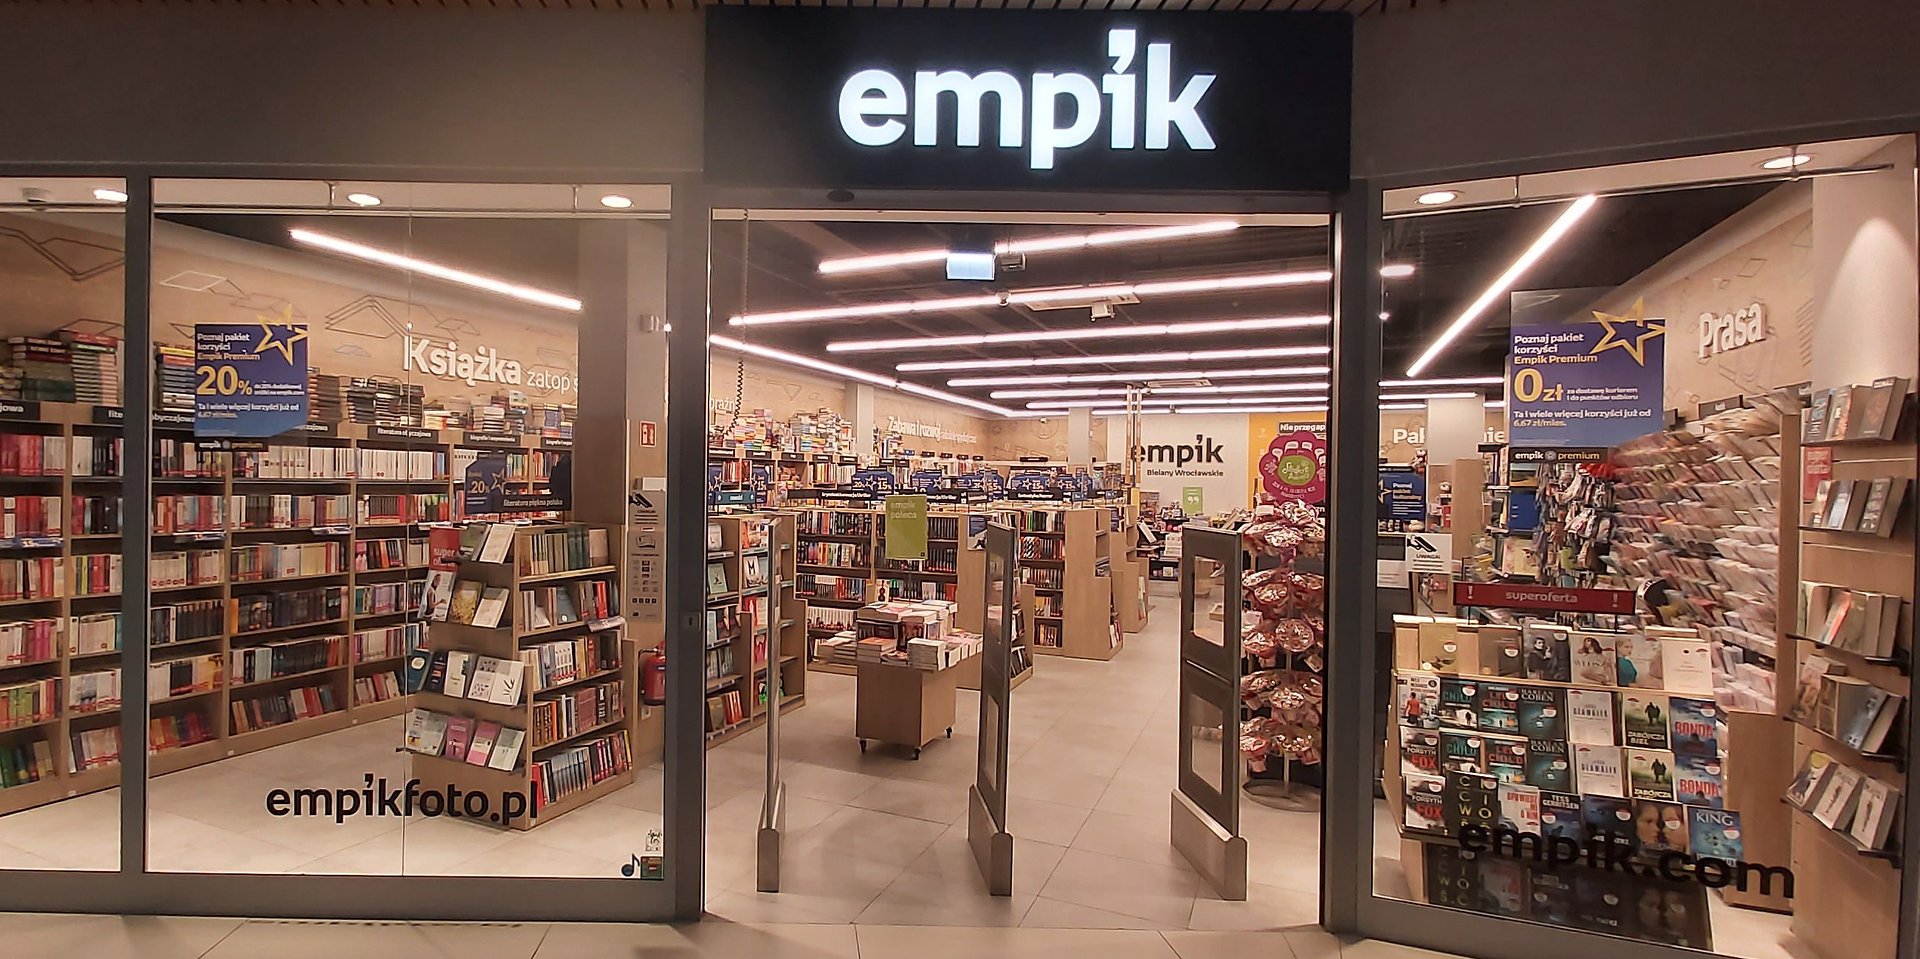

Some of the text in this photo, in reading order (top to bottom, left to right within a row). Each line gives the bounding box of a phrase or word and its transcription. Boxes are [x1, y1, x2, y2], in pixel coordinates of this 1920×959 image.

[838, 29, 1217, 170] empik
[1699, 302, 1766, 358] Prasa
[197, 333, 251, 342] Poznaj pakiet
[1514, 333, 1585, 344] Poznaj pakiet
[197, 343, 232, 352] korzyści
[1514, 345, 1558, 354] korzyści
[197, 353, 222, 361] Empik
[1514, 354, 1598, 365] Empik Premium
[404, 336, 521, 387] Książka
[527, 370, 571, 394] zatop
[291, 403, 299, 411] od
[1514, 410, 1524, 418] Ta
[1529, 410, 1553, 418] wiele
[1554, 410, 1584, 420] więcej
[1584, 410, 1623, 419] korzyści
[1623, 409, 1638, 419] już
[1638, 409, 1652, 418] od
[888, 416, 916, 435] Zabawa
[1514, 420, 1532, 428] 6,67
[1131, 434, 1224, 467] empik
[1514, 450, 1600, 461] empik premium
[1146, 469, 1224, 477] Bielany Wrocławskie
[1506, 591, 1578, 604] superoferta
[1675, 721, 1714, 738] BONDA
[1627, 731, 1665, 741] ZABÓJCZA
[1680, 778, 1719, 797] BONDA
[266, 773, 538, 824] empikfoto.pl
[1634, 788, 1672, 799] ZABÓJCZA
[1542, 799, 1580, 810] GERRITSEN
[1696, 811, 1734, 826] KING
[1458, 820, 1795, 899] empik.com
